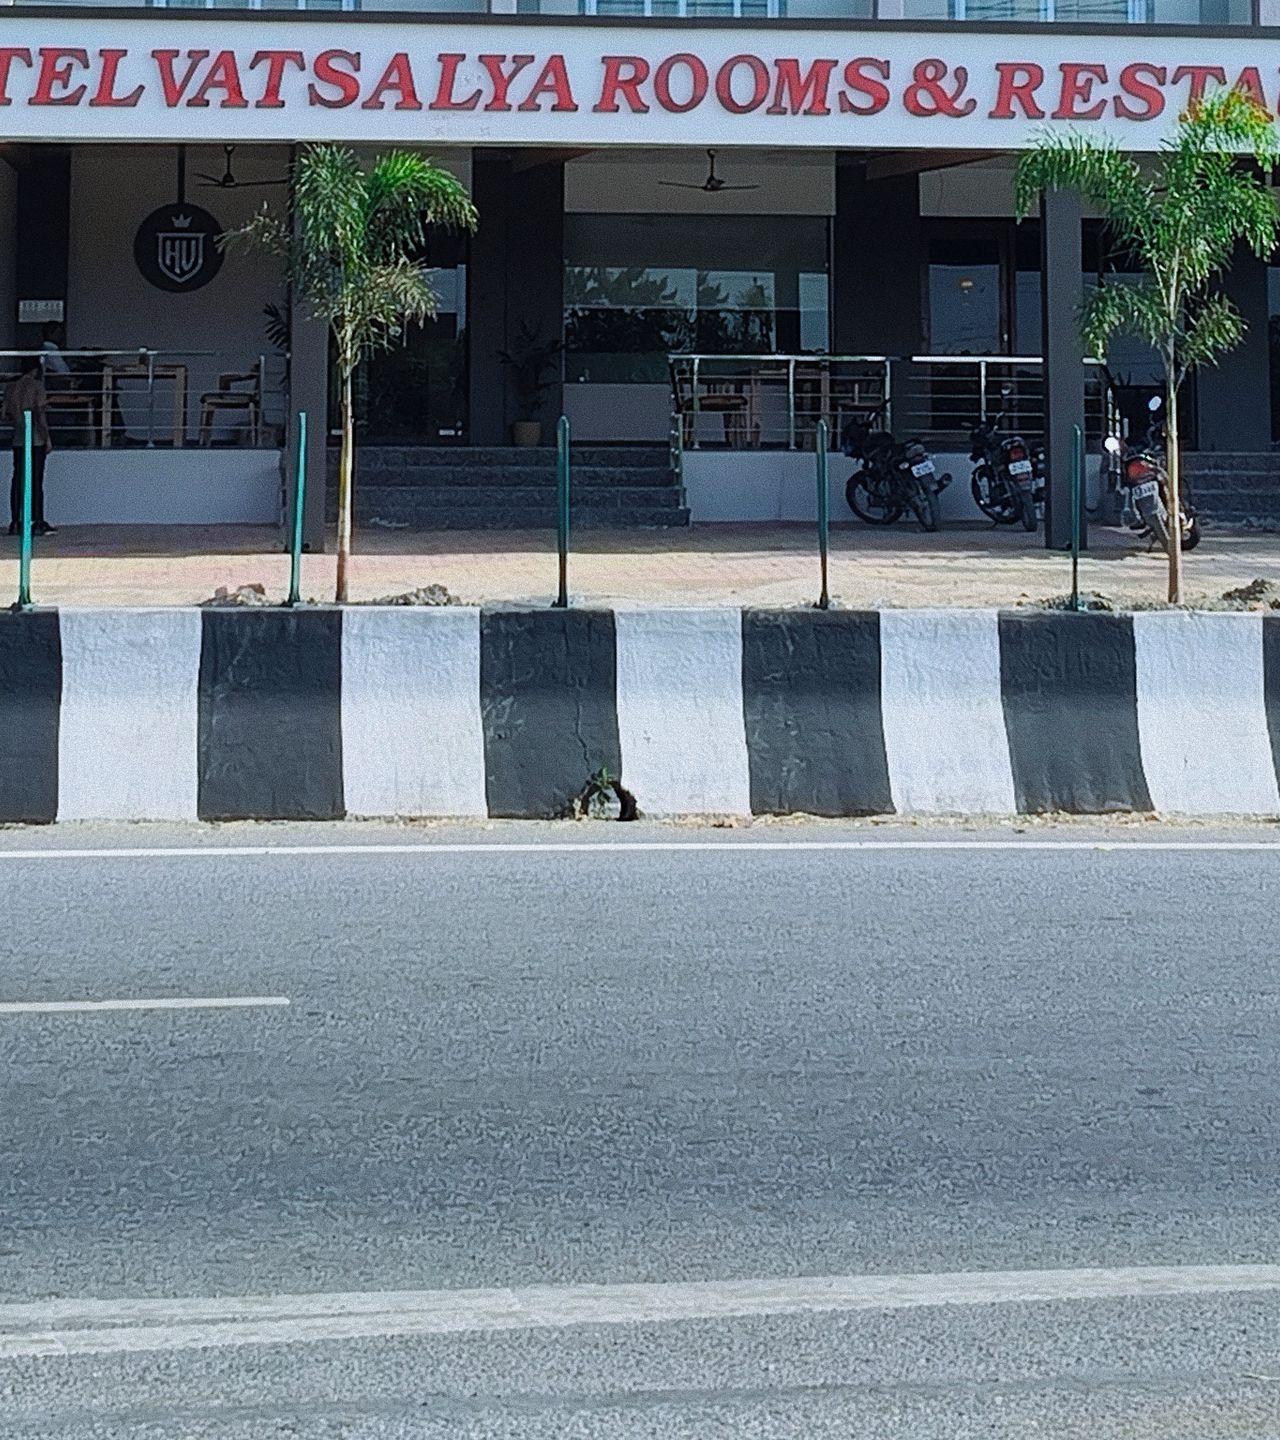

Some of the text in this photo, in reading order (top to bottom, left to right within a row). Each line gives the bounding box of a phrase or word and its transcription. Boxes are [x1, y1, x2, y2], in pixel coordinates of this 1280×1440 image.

[151, 48, 578, 113] VATSALYA
[593, 53, 891, 117] ROOMS
[903, 58, 977, 118] &
